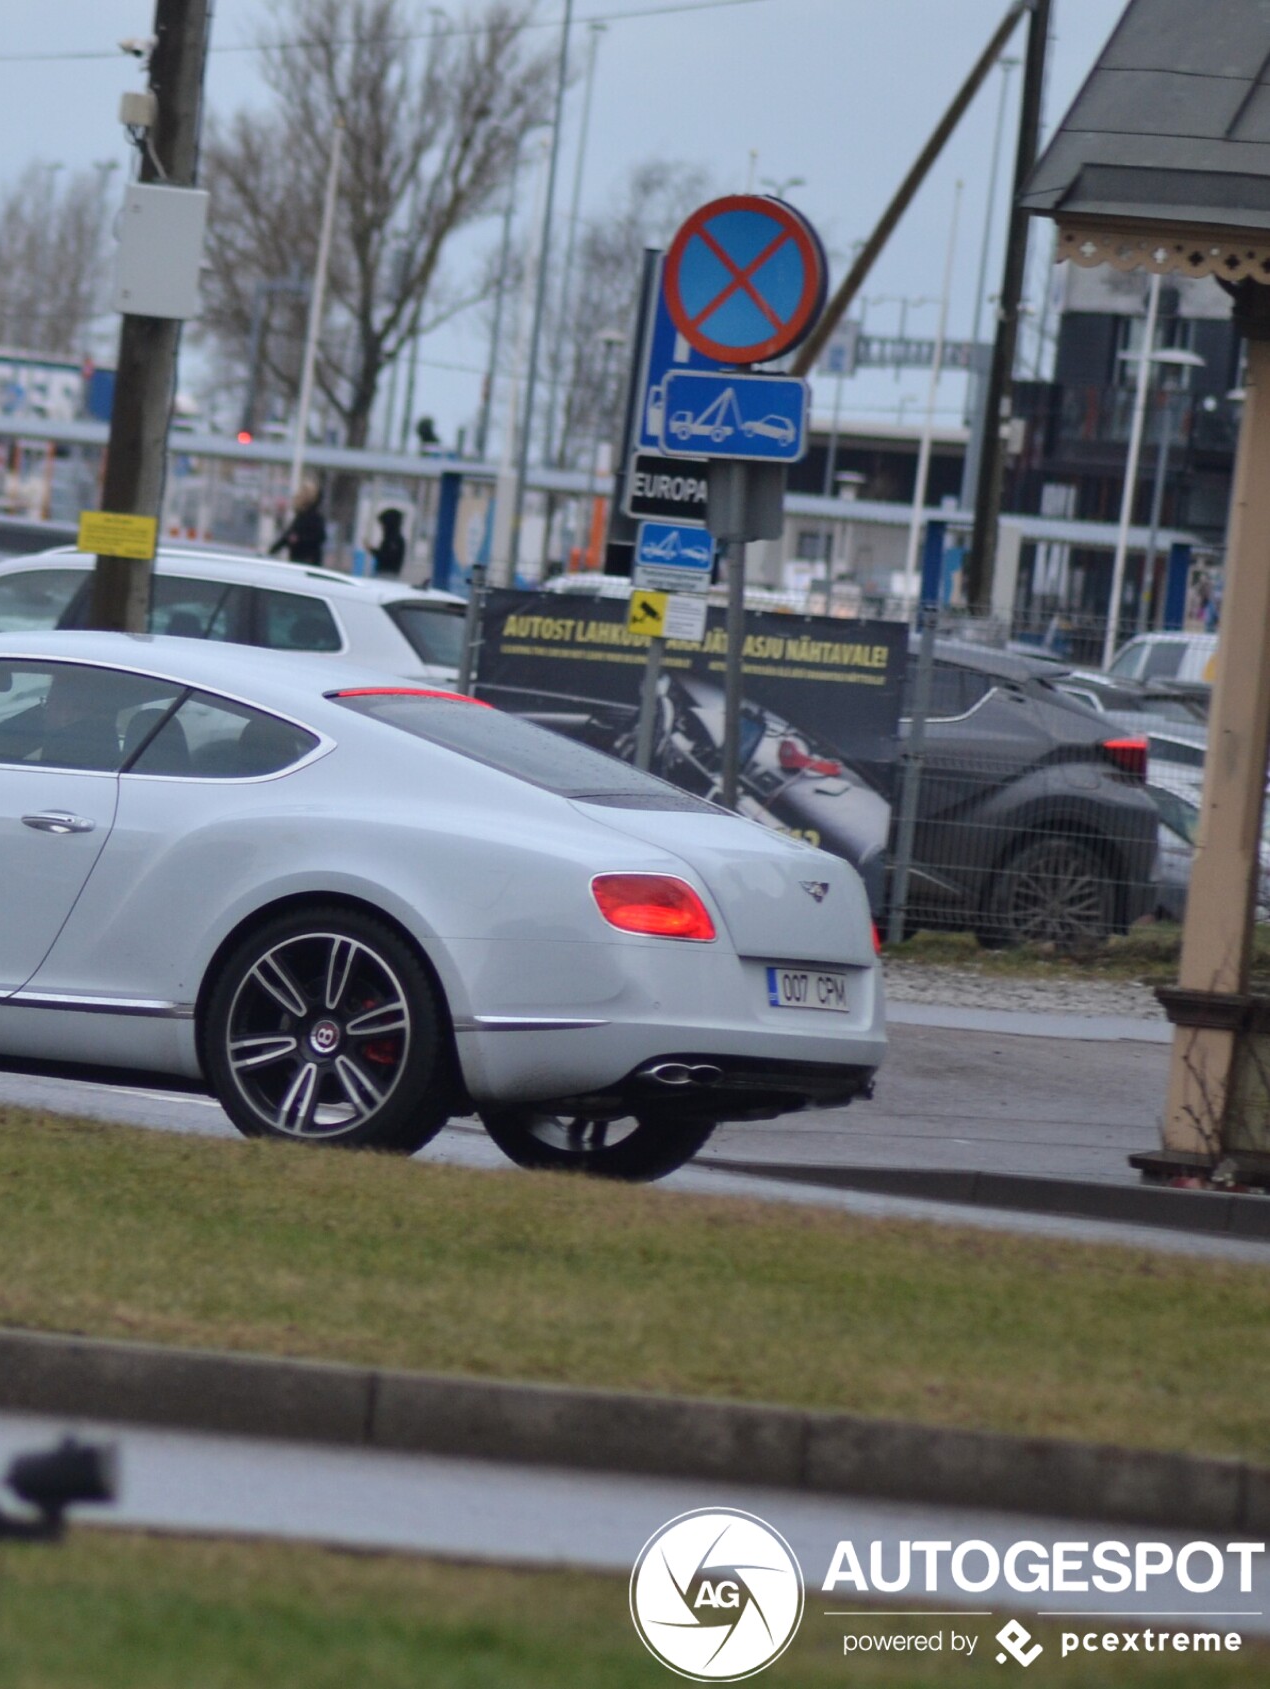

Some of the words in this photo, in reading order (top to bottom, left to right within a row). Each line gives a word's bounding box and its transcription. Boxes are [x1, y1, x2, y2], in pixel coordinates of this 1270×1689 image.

[503, 614, 575, 642] AUTOST
[741, 634, 785, 660] ASJU
[785, 635, 889, 669] NÄHTAVALE!
[783, 974, 808, 1003] 007
[817, 976, 847, 1007] CPM
